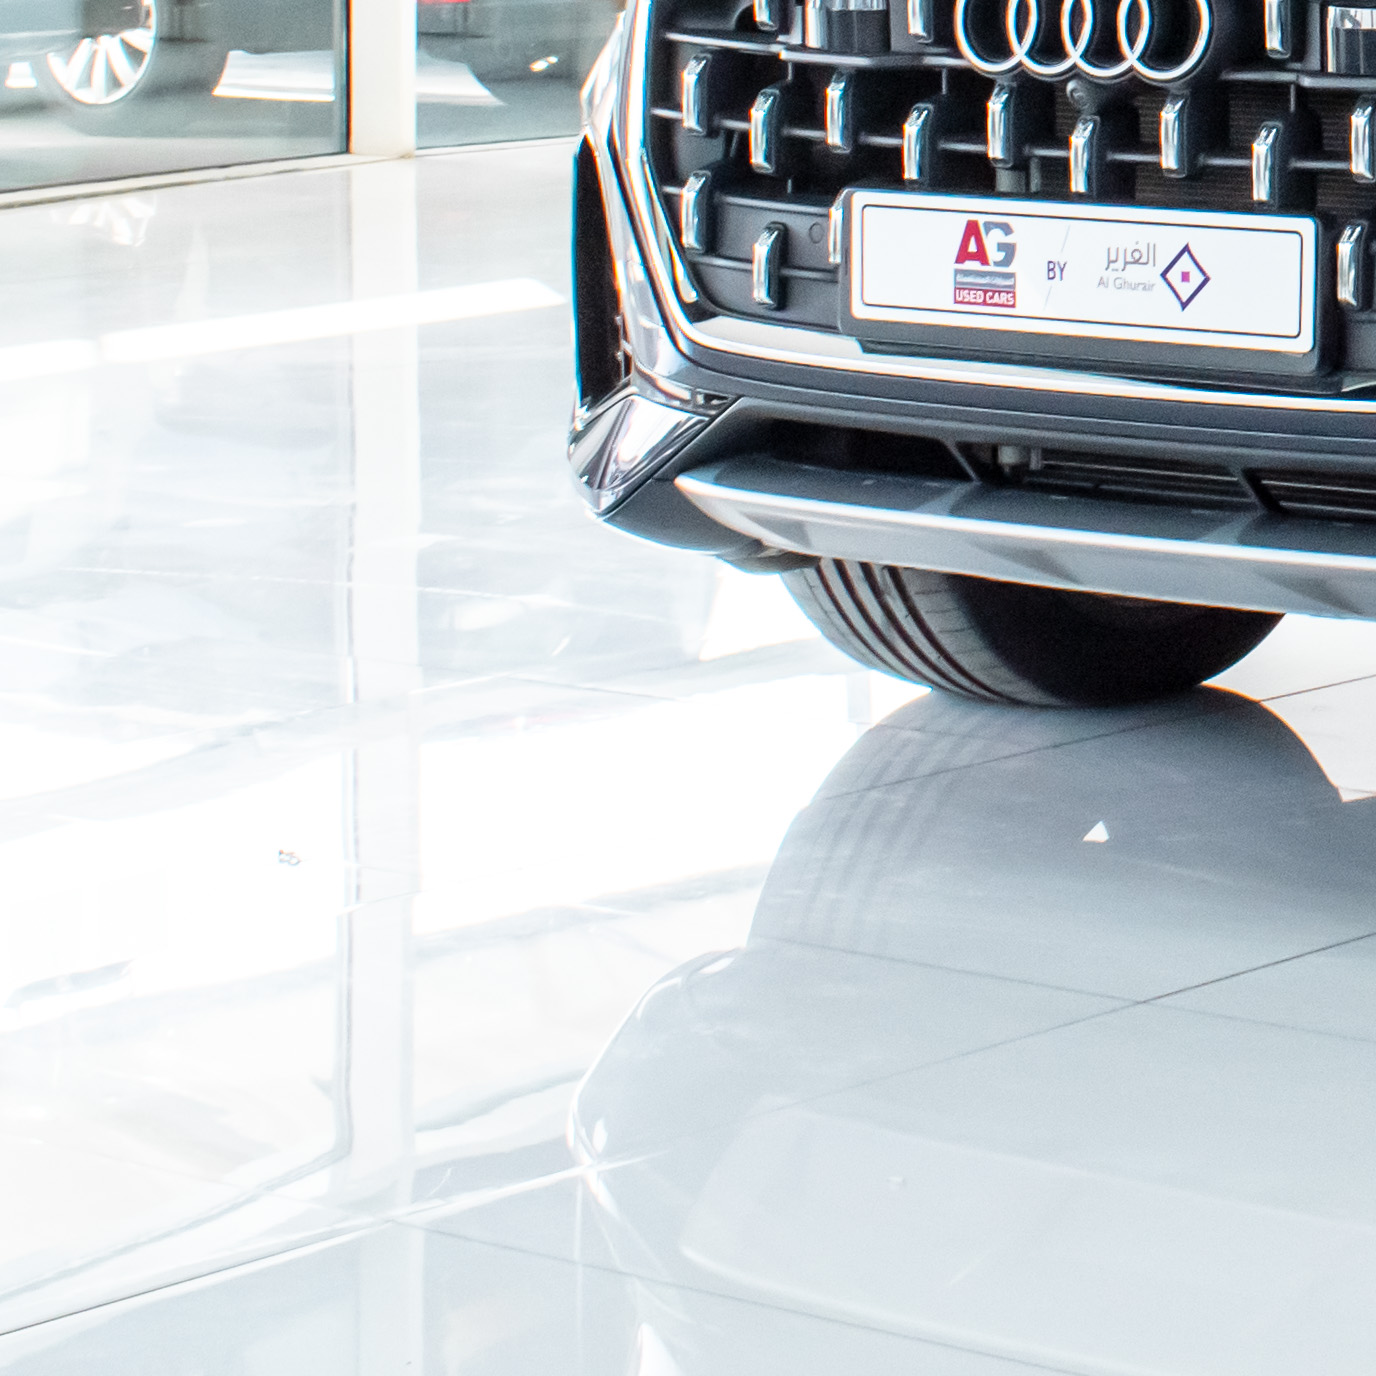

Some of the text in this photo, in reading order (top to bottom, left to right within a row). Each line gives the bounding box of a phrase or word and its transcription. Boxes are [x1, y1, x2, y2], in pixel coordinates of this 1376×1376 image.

[954, 219, 1017, 267] AG
[1104, 241, 1157, 271] الغرير
[1047, 261, 1066, 281] BY
[1097, 275, 1156, 293] Al Ghurair
[955, 289, 1015, 305] USED CARS
